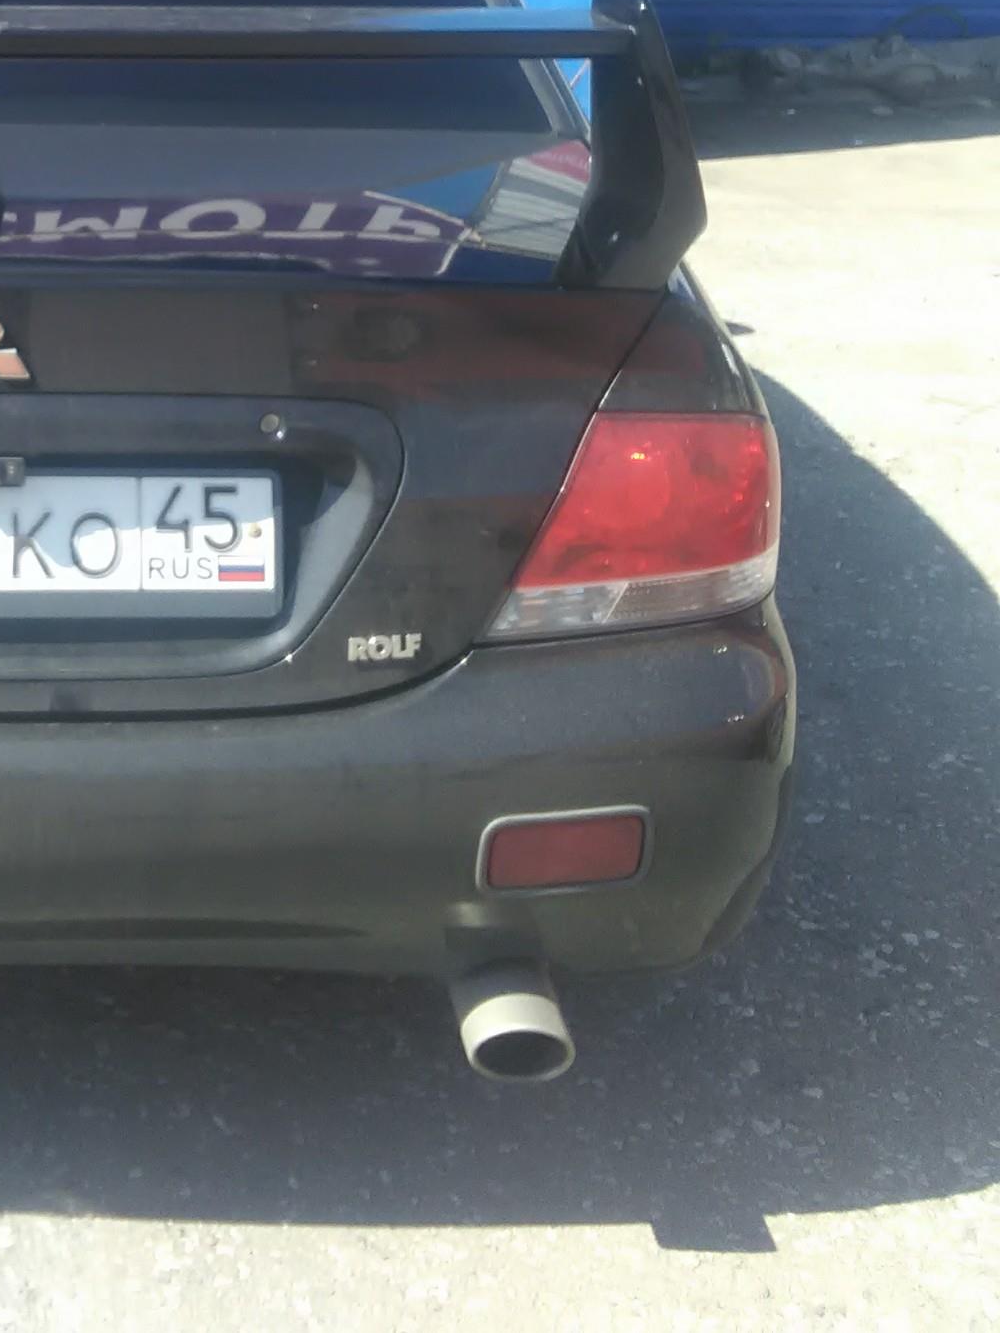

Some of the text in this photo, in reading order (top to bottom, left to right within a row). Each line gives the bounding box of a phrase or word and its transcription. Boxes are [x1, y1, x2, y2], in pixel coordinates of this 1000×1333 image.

[154, 484, 242, 553] 45
[148, 556, 214, 581] RUS
[346, 632, 422, 662] ROLF
